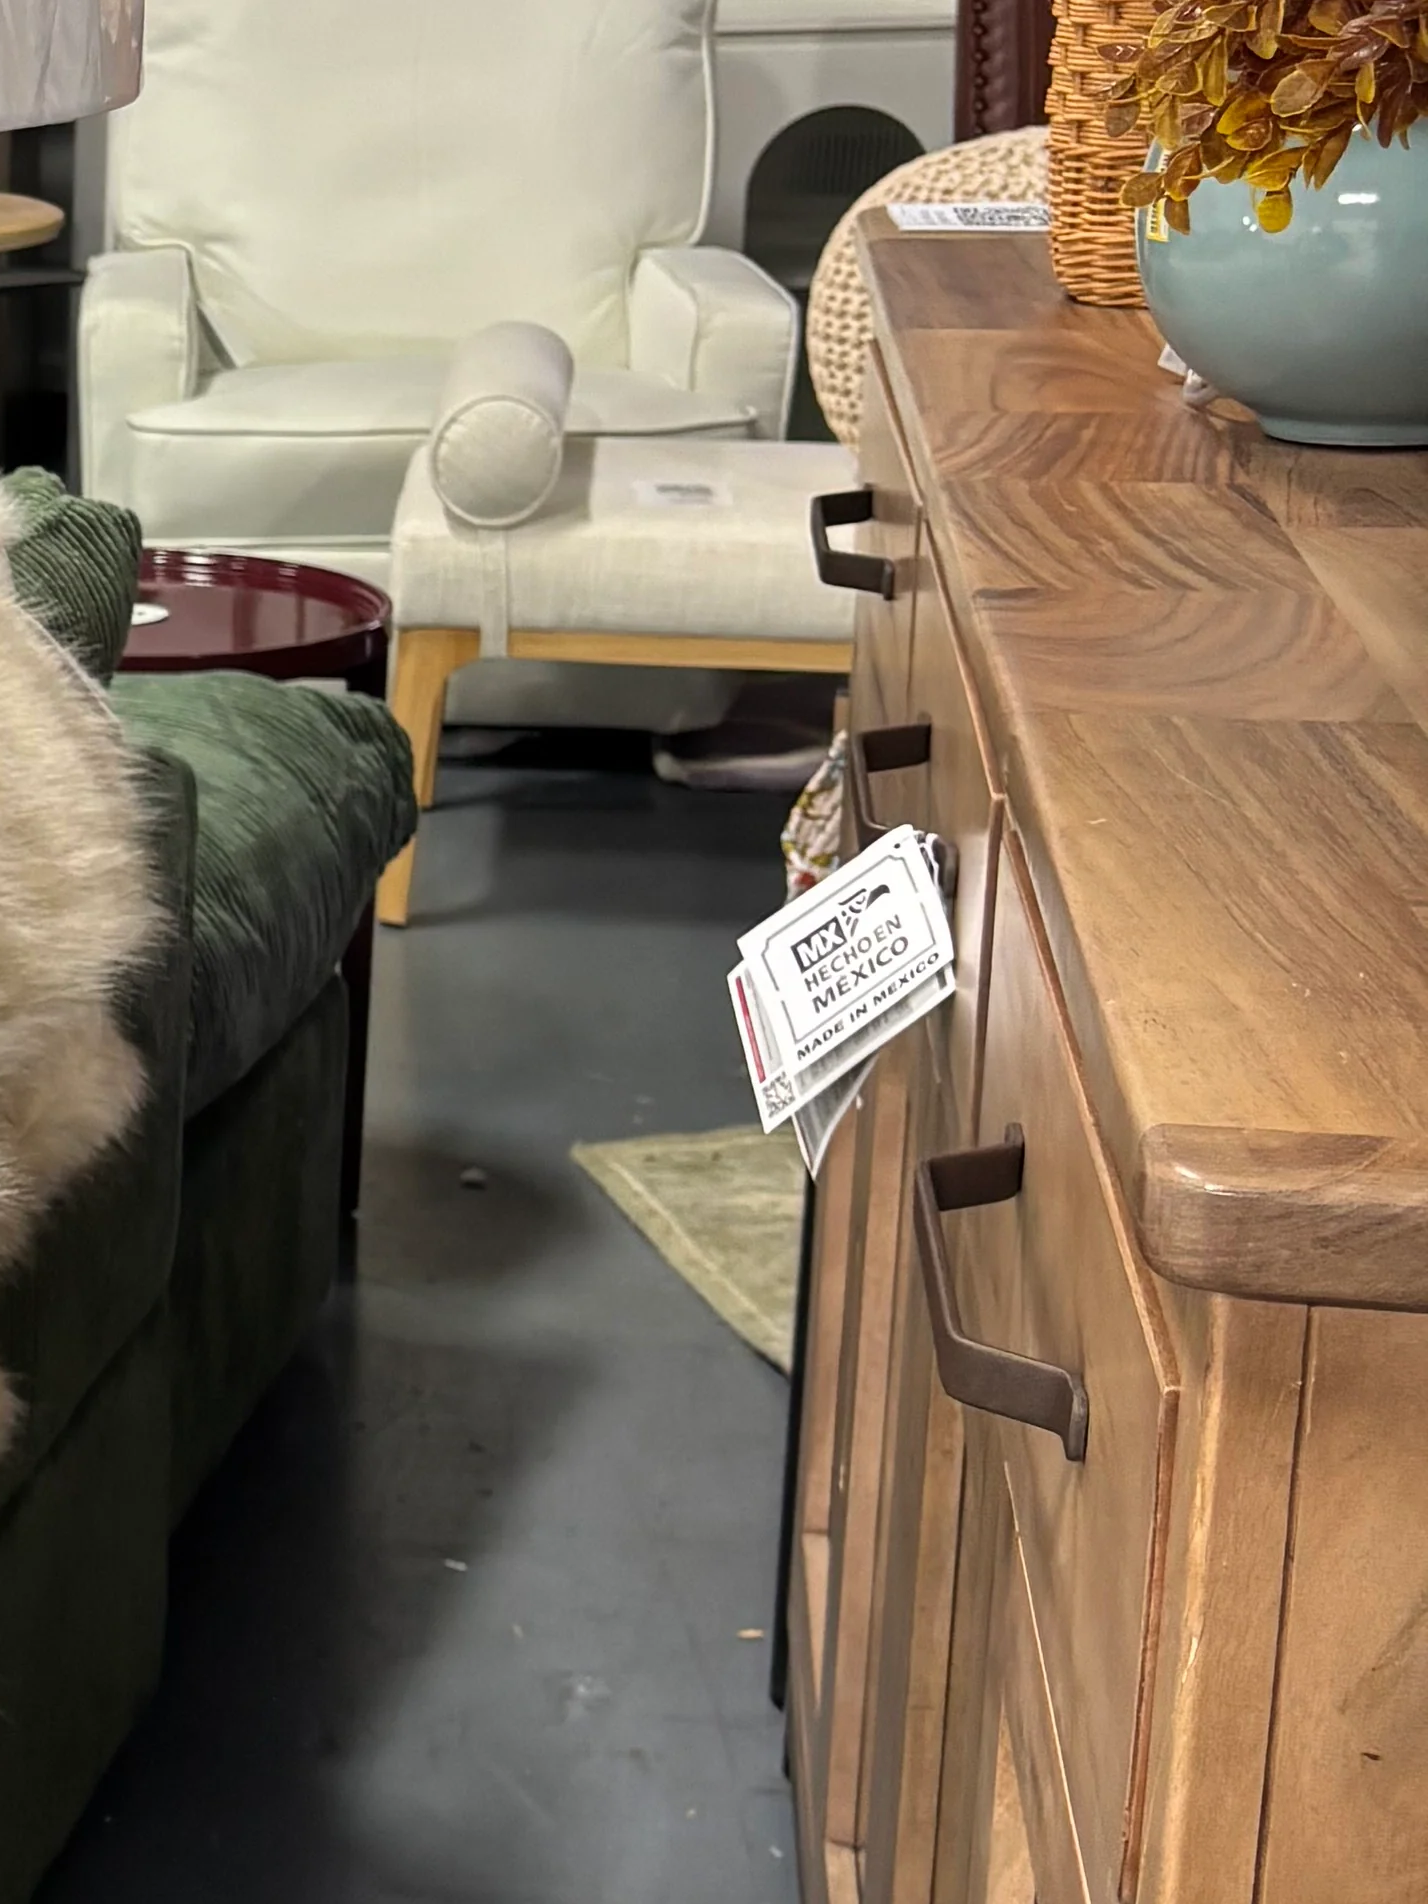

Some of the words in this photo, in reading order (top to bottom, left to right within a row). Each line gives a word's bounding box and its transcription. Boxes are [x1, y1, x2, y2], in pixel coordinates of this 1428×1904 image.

[796, 921, 846, 969] MX
[804, 937, 872, 992] HECHO
[873, 914, 902, 943] EN
[797, 1023, 844, 1061] MADE
[849, 1003, 868, 1023] IN
[872, 952, 940, 1007] MEXICO
